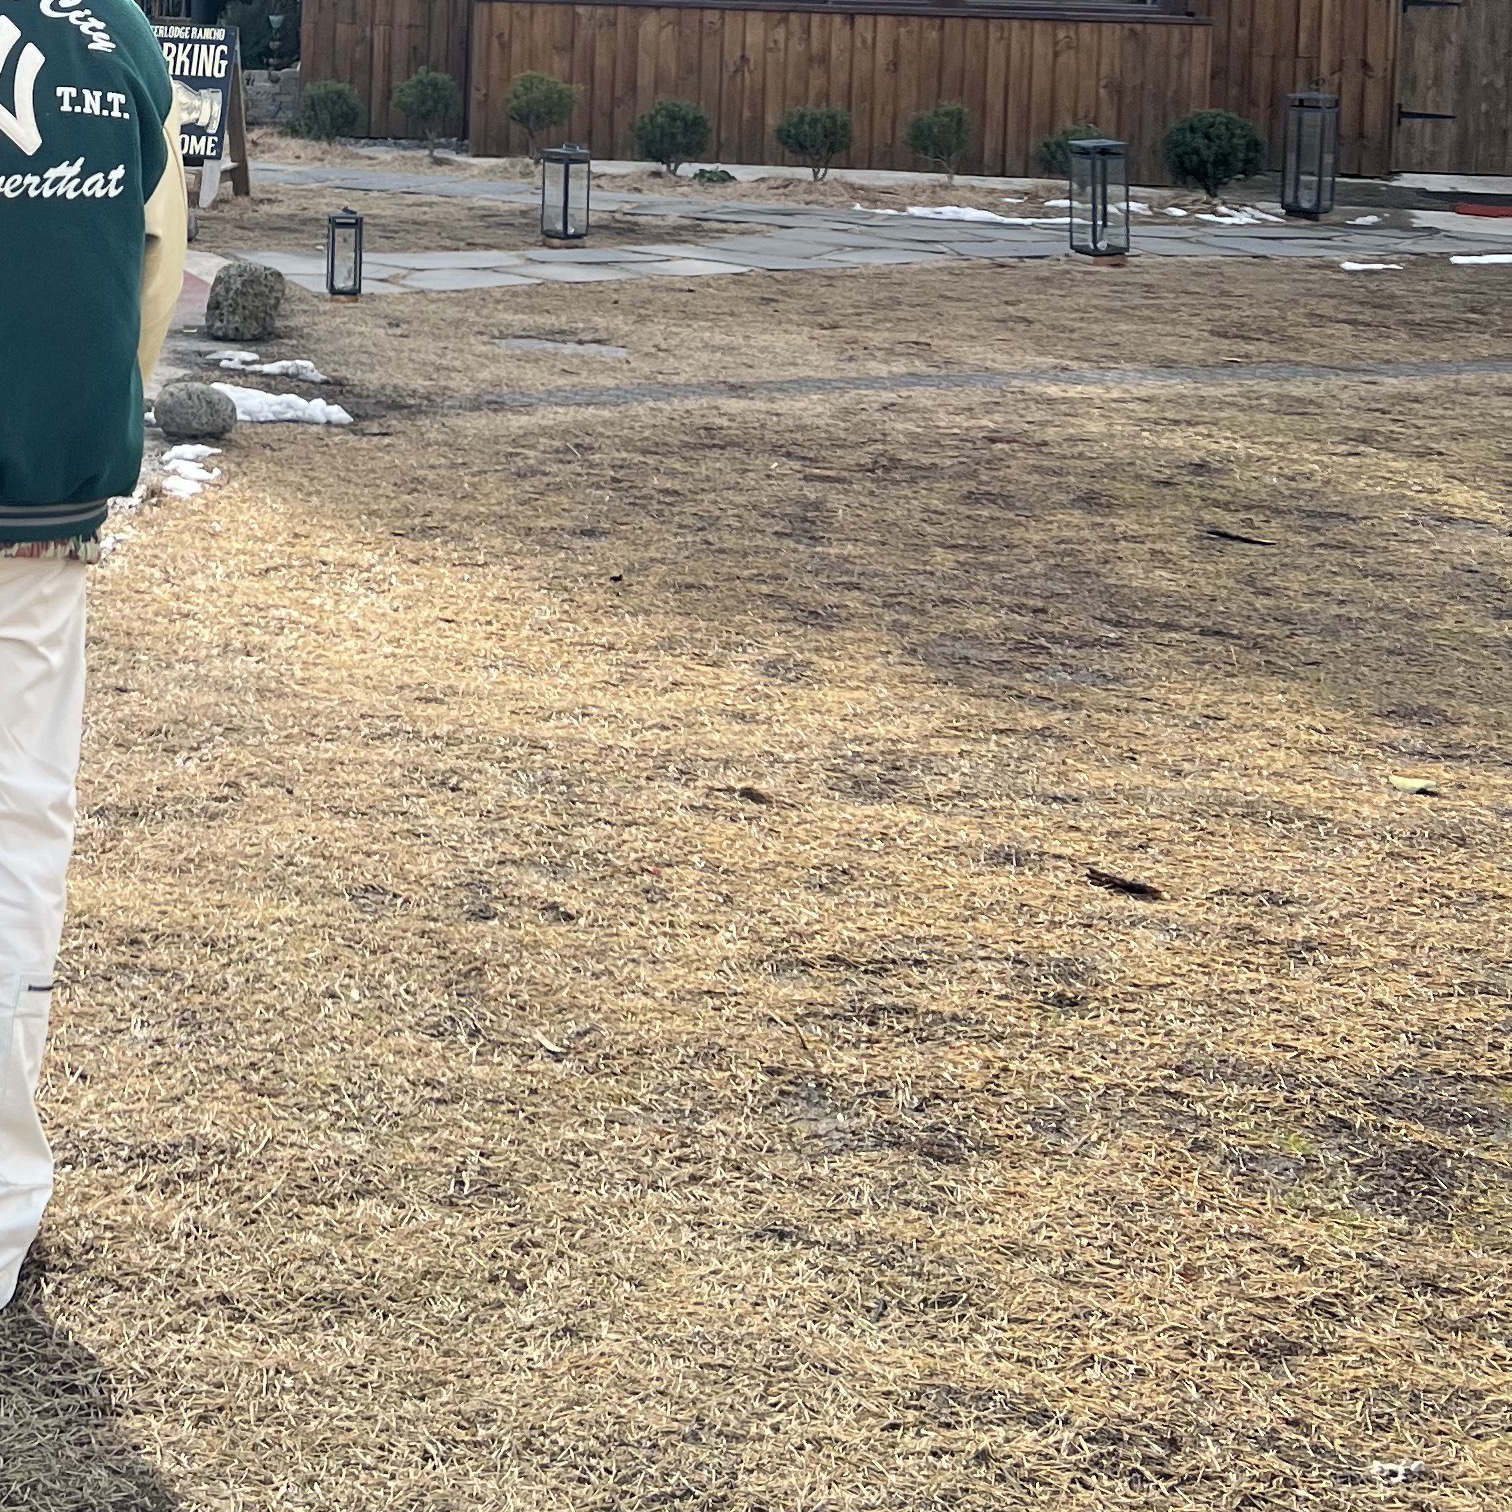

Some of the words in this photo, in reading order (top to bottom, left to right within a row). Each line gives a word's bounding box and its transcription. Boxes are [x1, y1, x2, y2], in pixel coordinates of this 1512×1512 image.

[191, 27, 226, 41] RANCHO
[162, 42, 228, 78] RKING
[56, 86, 130, 119] T.N.T.
[179, 134, 219, 156] OME
